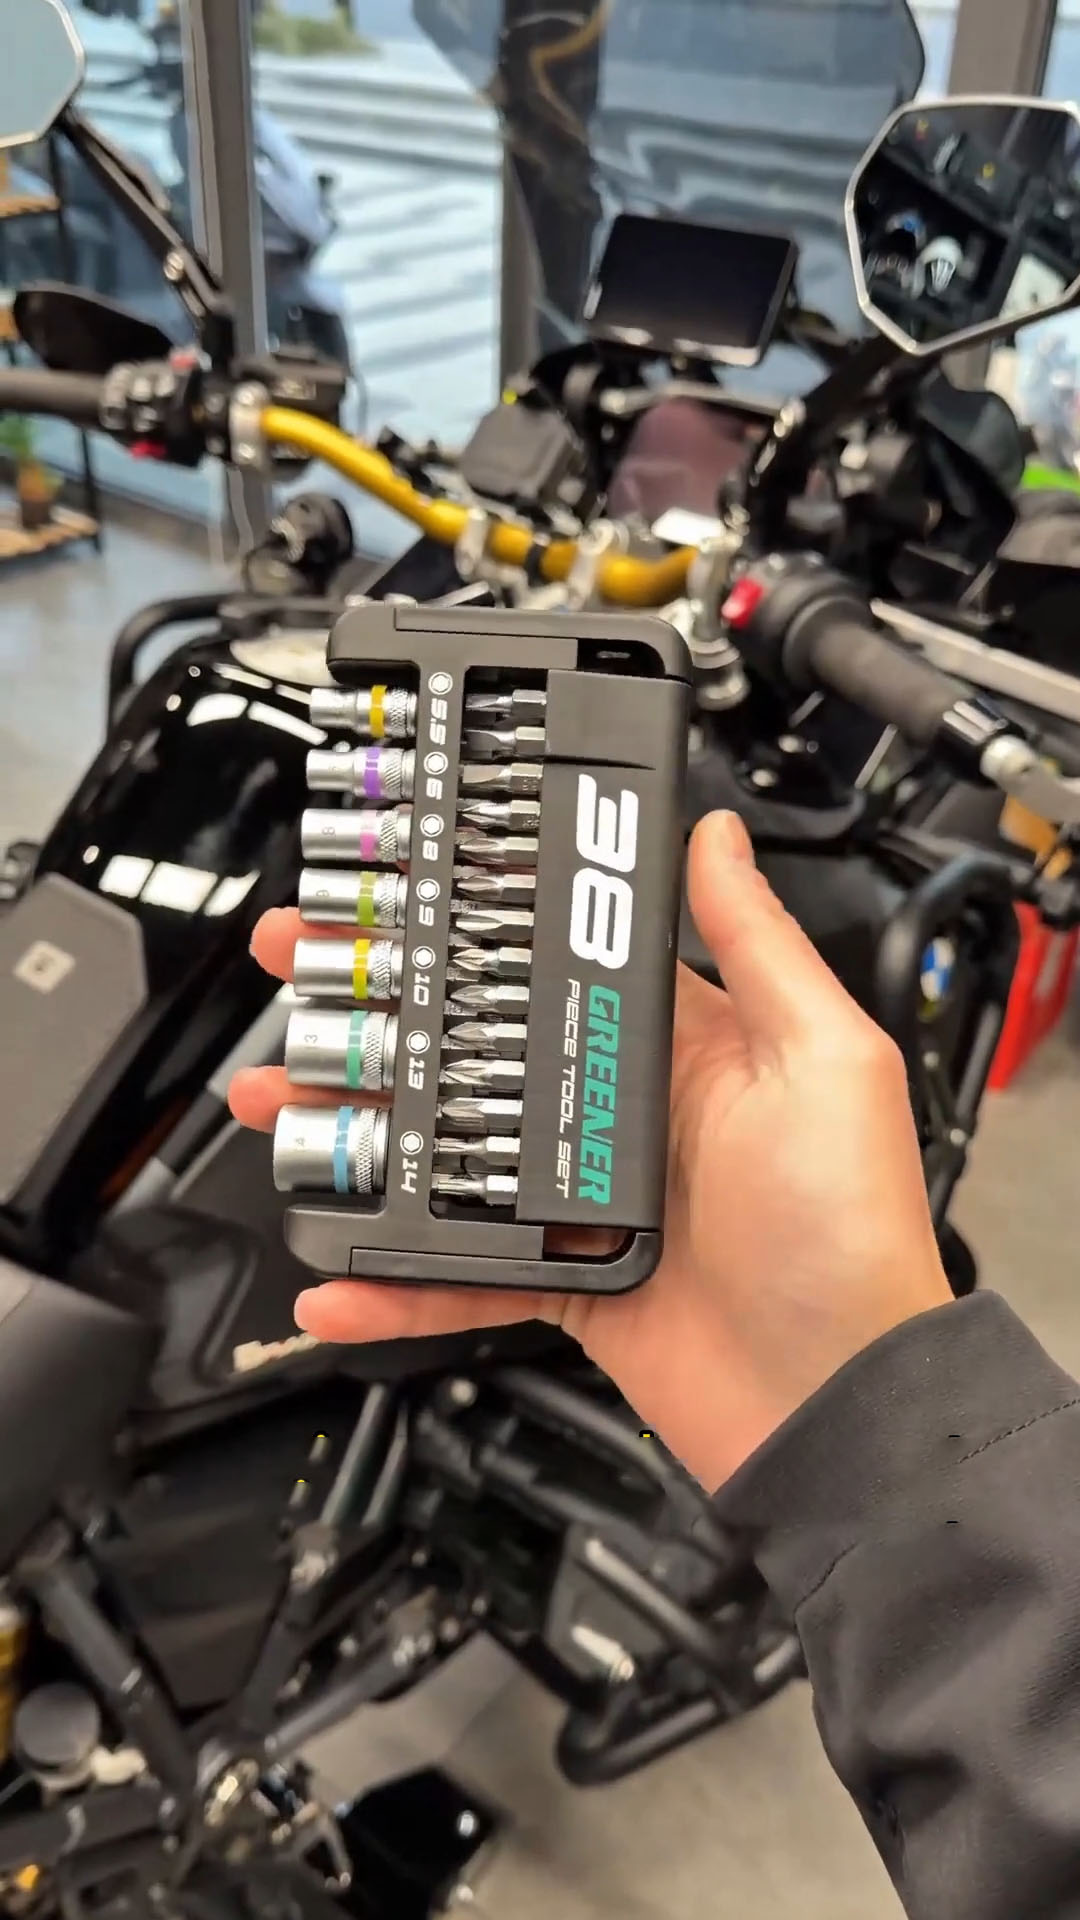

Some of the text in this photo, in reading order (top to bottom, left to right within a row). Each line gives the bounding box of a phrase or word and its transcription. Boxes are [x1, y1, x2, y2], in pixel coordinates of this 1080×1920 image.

[429, 698, 449, 746] 5.5
[426, 777, 444, 800] 6
[422, 839, 439, 862] 8
[569, 773, 639, 970] 38
[418, 904, 435, 927] 9
[413, 972, 431, 1007] 10
[408, 1056, 426, 1091] 13
[556, 978, 581, 1199] PIECE TOOL SET
[577, 984, 621, 1205] GREENER
[401, 1157, 419, 1194] 14
